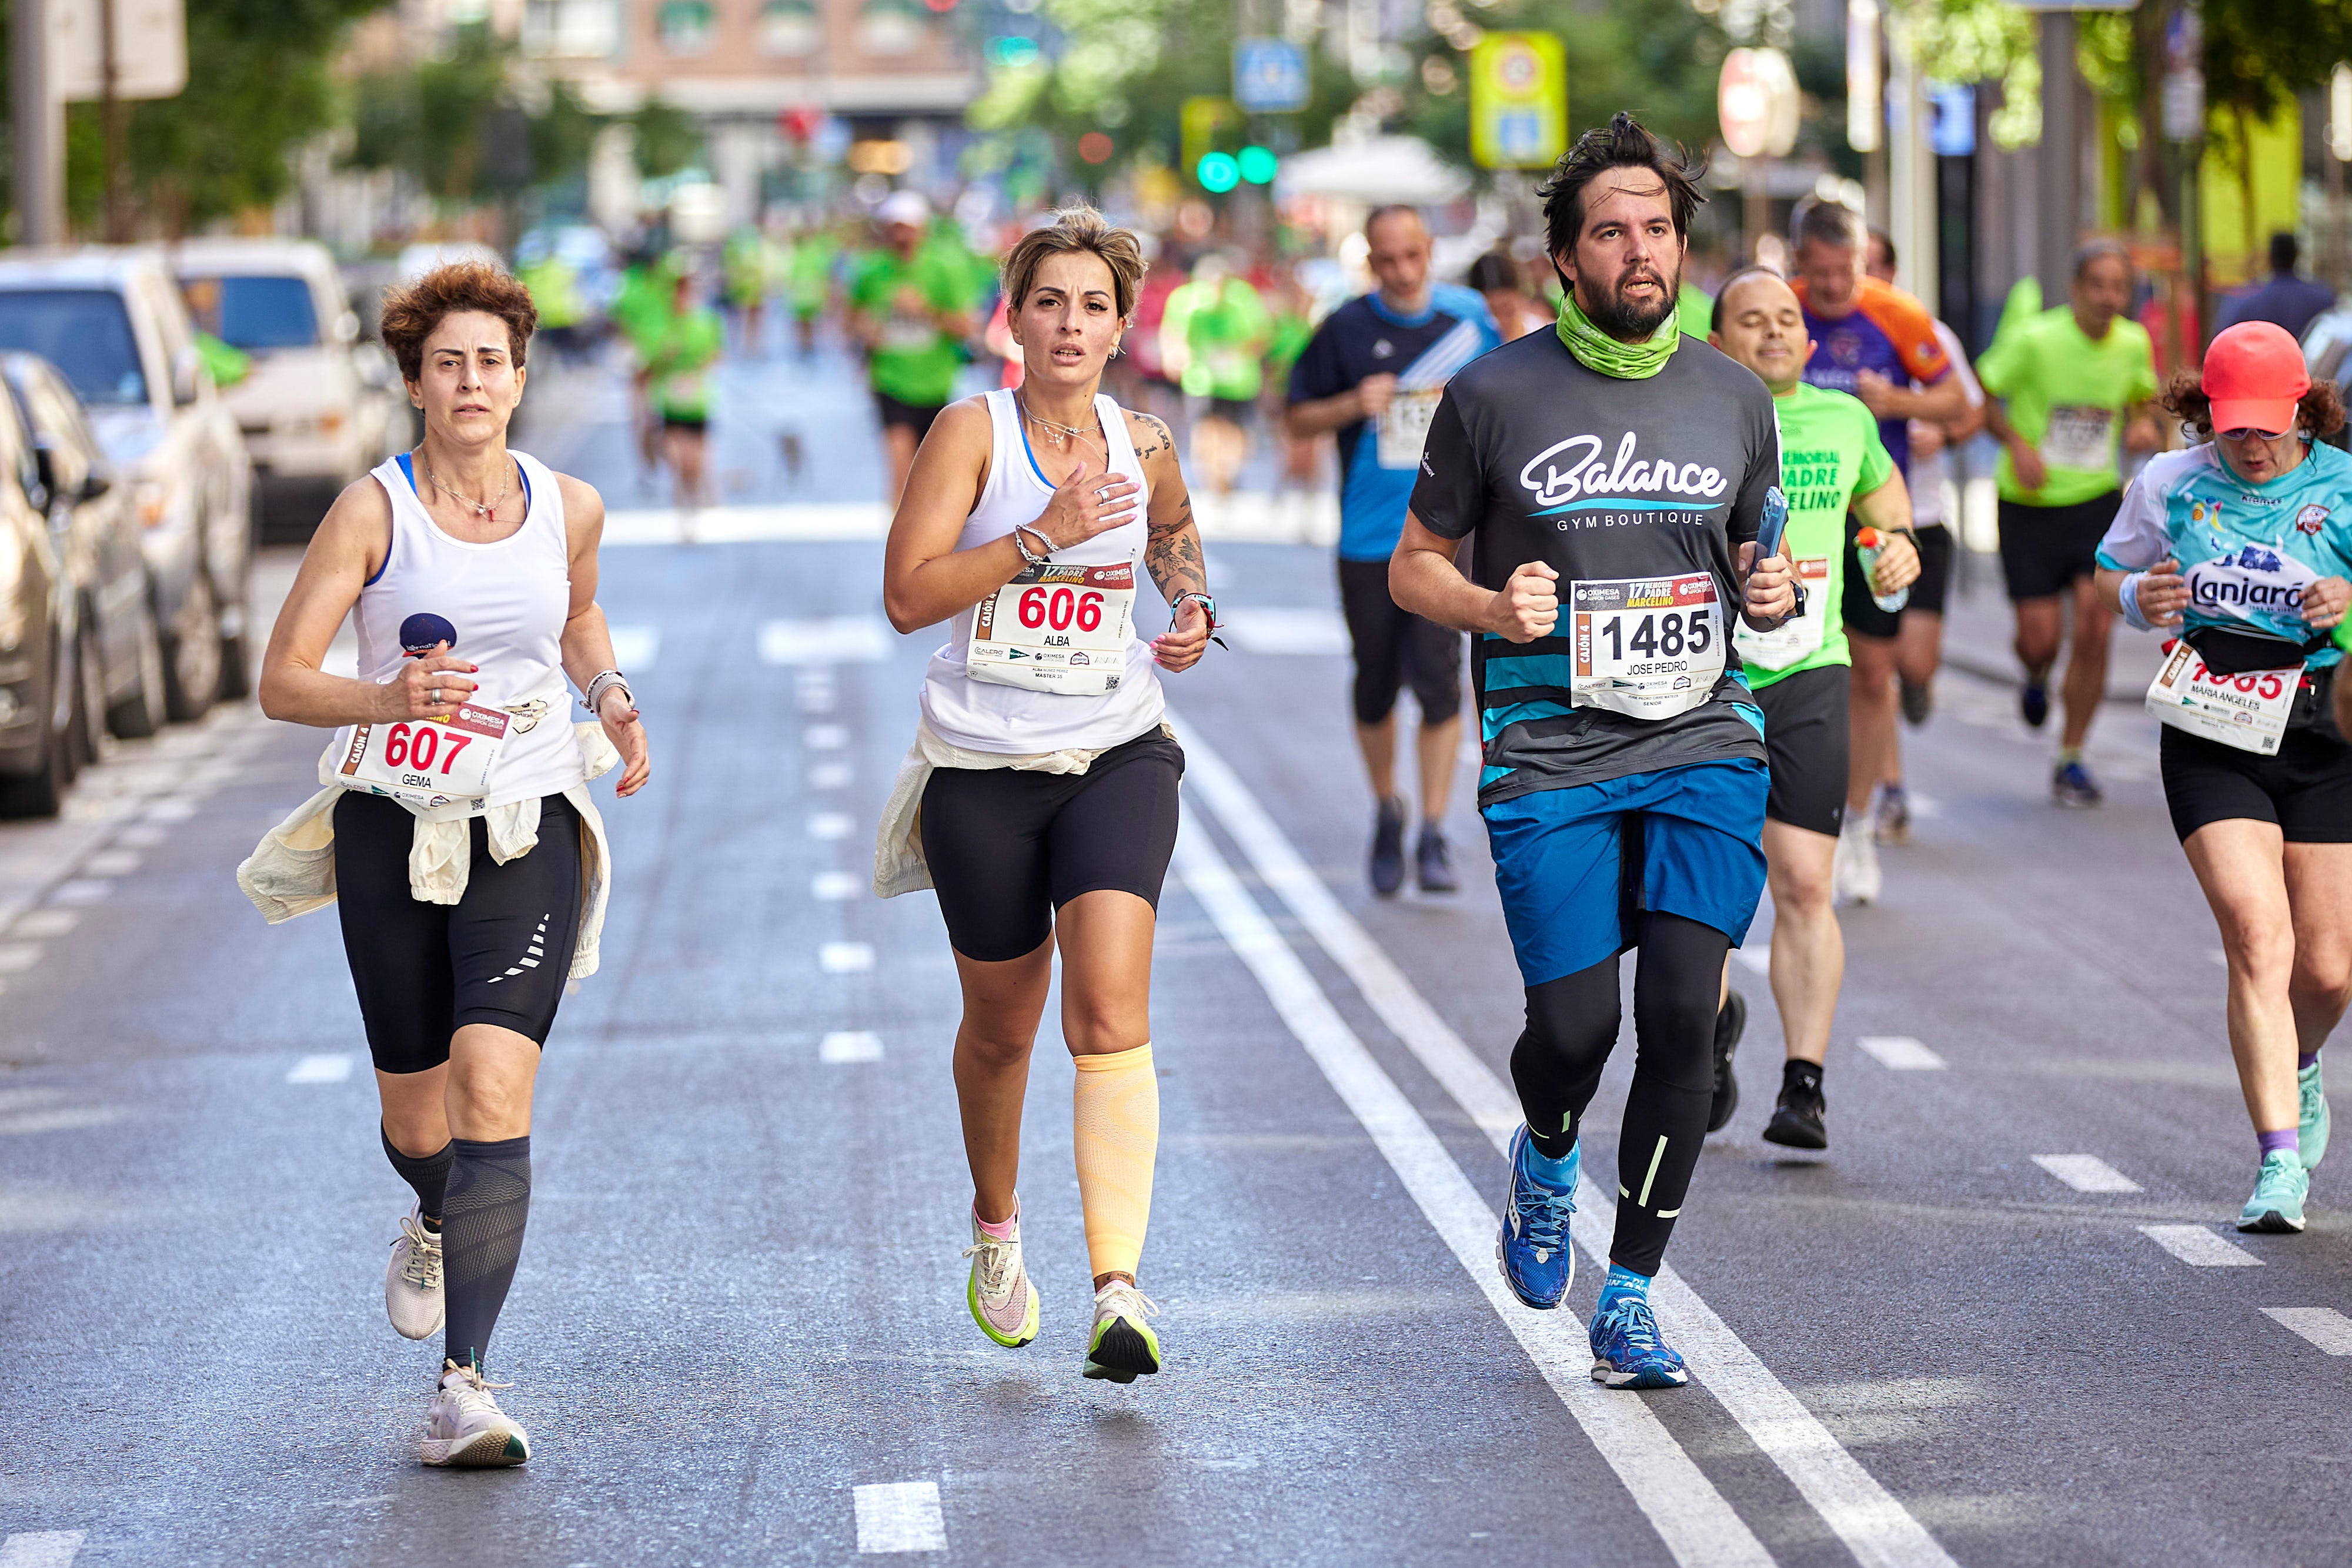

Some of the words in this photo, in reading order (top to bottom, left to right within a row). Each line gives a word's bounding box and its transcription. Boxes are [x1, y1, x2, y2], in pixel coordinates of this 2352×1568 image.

[1520, 431, 1728, 506] Balance
[1782, 468, 1837, 487] ADRE
[1557, 513, 1598, 531] GYM
[1605, 512, 1703, 527] BOUTIQUE
[1038, 576, 1085, 584] MARCELINO
[1043, 566, 1060, 577] 17
[1105, 568, 1131, 577] OXIMESA
[1629, 582, 1645, 599] 17
[1644, 580, 1673, 589] MEMORIAL
[1645, 587, 1672, 598] PADRE
[1688, 580, 1712, 589] OXIMESA
[2191, 571, 2304, 607] Lanjaró
[1018, 587, 1104, 632] 606
[1626, 596, 1674, 607] MARCELINO
[981, 601, 995, 627] CAJÓN
[1044, 635, 1070, 647] ALBA
[1602, 610, 1711, 660] 1485
[1578, 633, 1591, 663] CAJÓN
[1627, 663, 1653, 676] JOSE
[1655, 661, 1688, 673] PEDRO
[2191, 684, 2218, 700] MARIA
[2219, 692, 2260, 710] ANGELES
[472, 711, 505, 726] OXIMESA
[350, 735, 367, 764] CAJÓN
[385, 723, 472, 774] 607
[402, 774, 432, 788] GEMA
